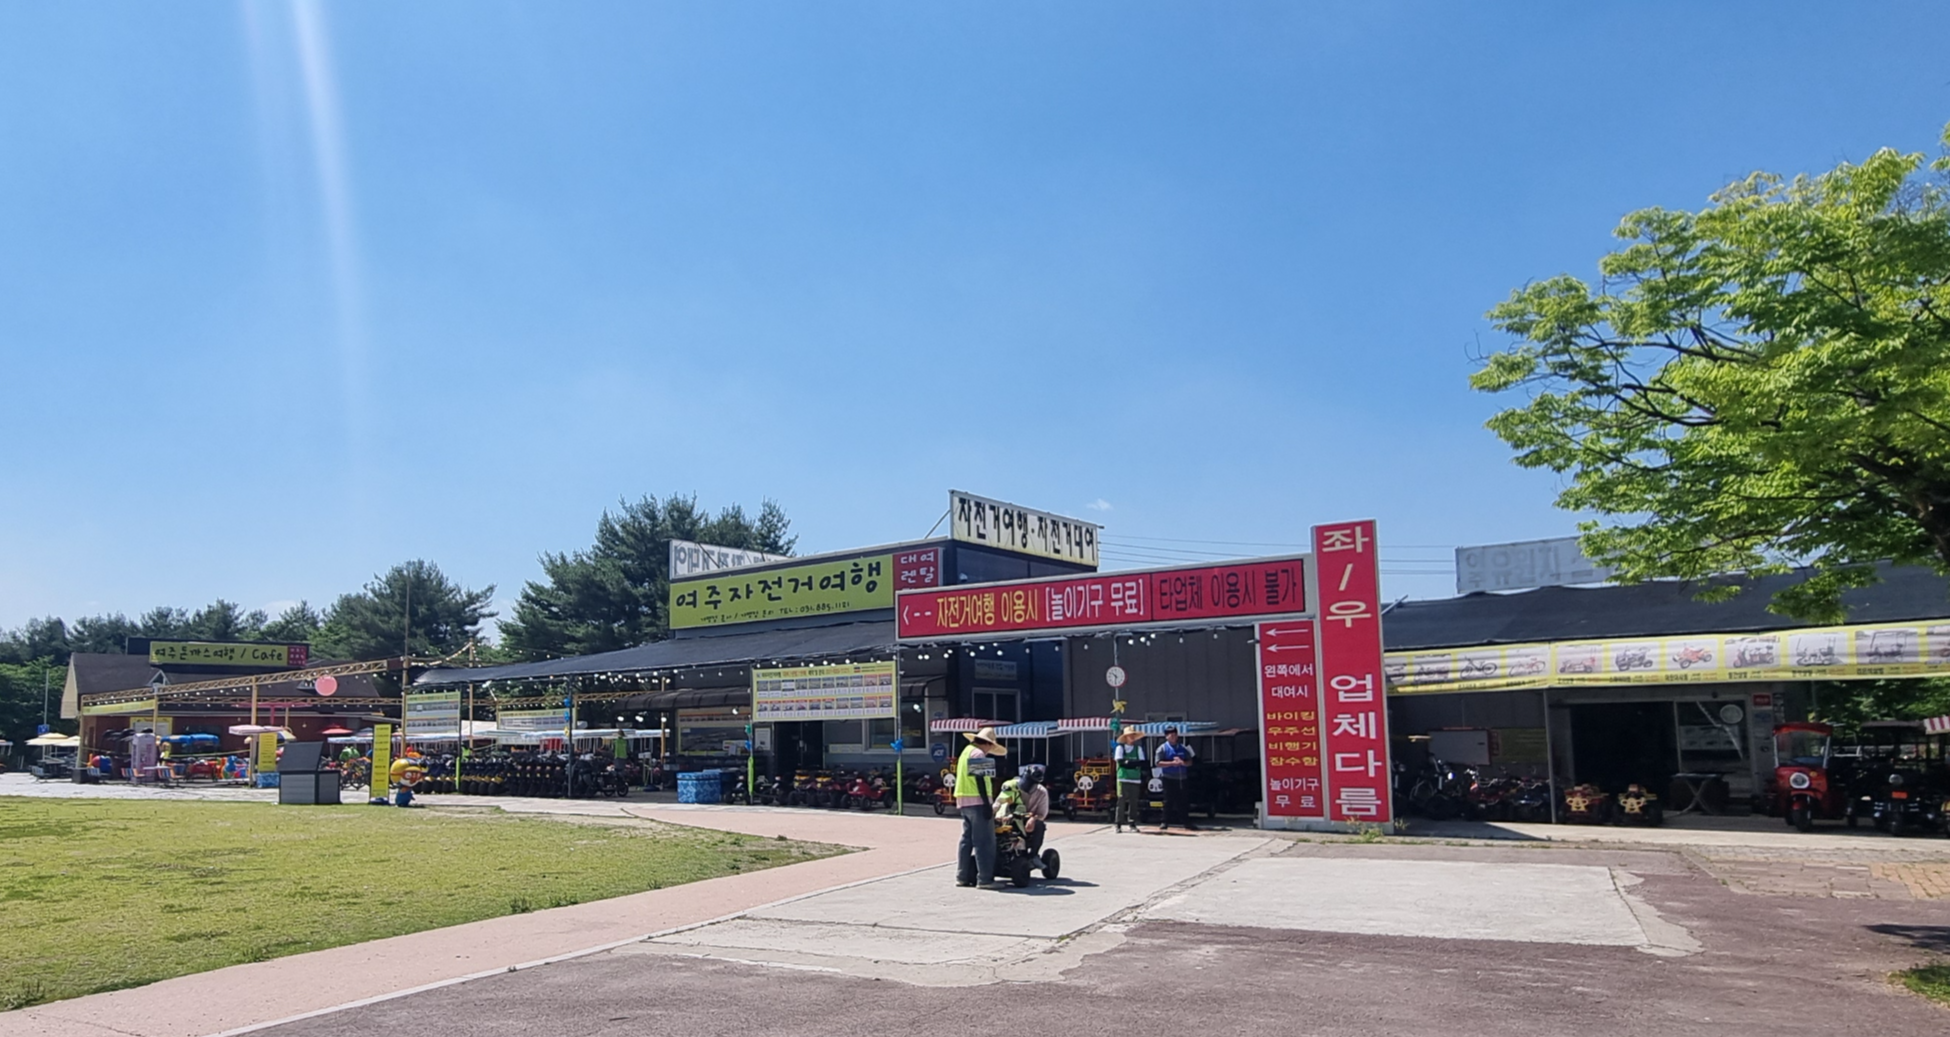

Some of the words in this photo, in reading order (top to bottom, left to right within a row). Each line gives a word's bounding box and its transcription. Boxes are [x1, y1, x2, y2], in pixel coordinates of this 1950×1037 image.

[900, 551, 935, 564] 대여
[900, 566, 935, 584] 렌탈
[675, 560, 882, 611] 여주자전거여행
[936, 590, 996, 629] 자전거여행
[1000, 587, 1039, 622] 이용시
[1159, 576, 1203, 612] 타업체
[1211, 571, 1255, 609] 이용시
[1264, 568, 1297, 605] 불가
[154, 645, 235, 661] 여주돈까스여행
[252, 648, 284, 661] Cafe
[1264, 663, 1314, 678] 왼쪽에서
[1271, 685, 1309, 699] 대여시
[1266, 710, 1316, 722] 바이킹
[1267, 726, 1317, 737] 우주선
[1268, 741, 1318, 751] 비행기
[1268, 756, 1319, 767] 잠수함
[1269, 777, 1320, 791] 놀이기구
